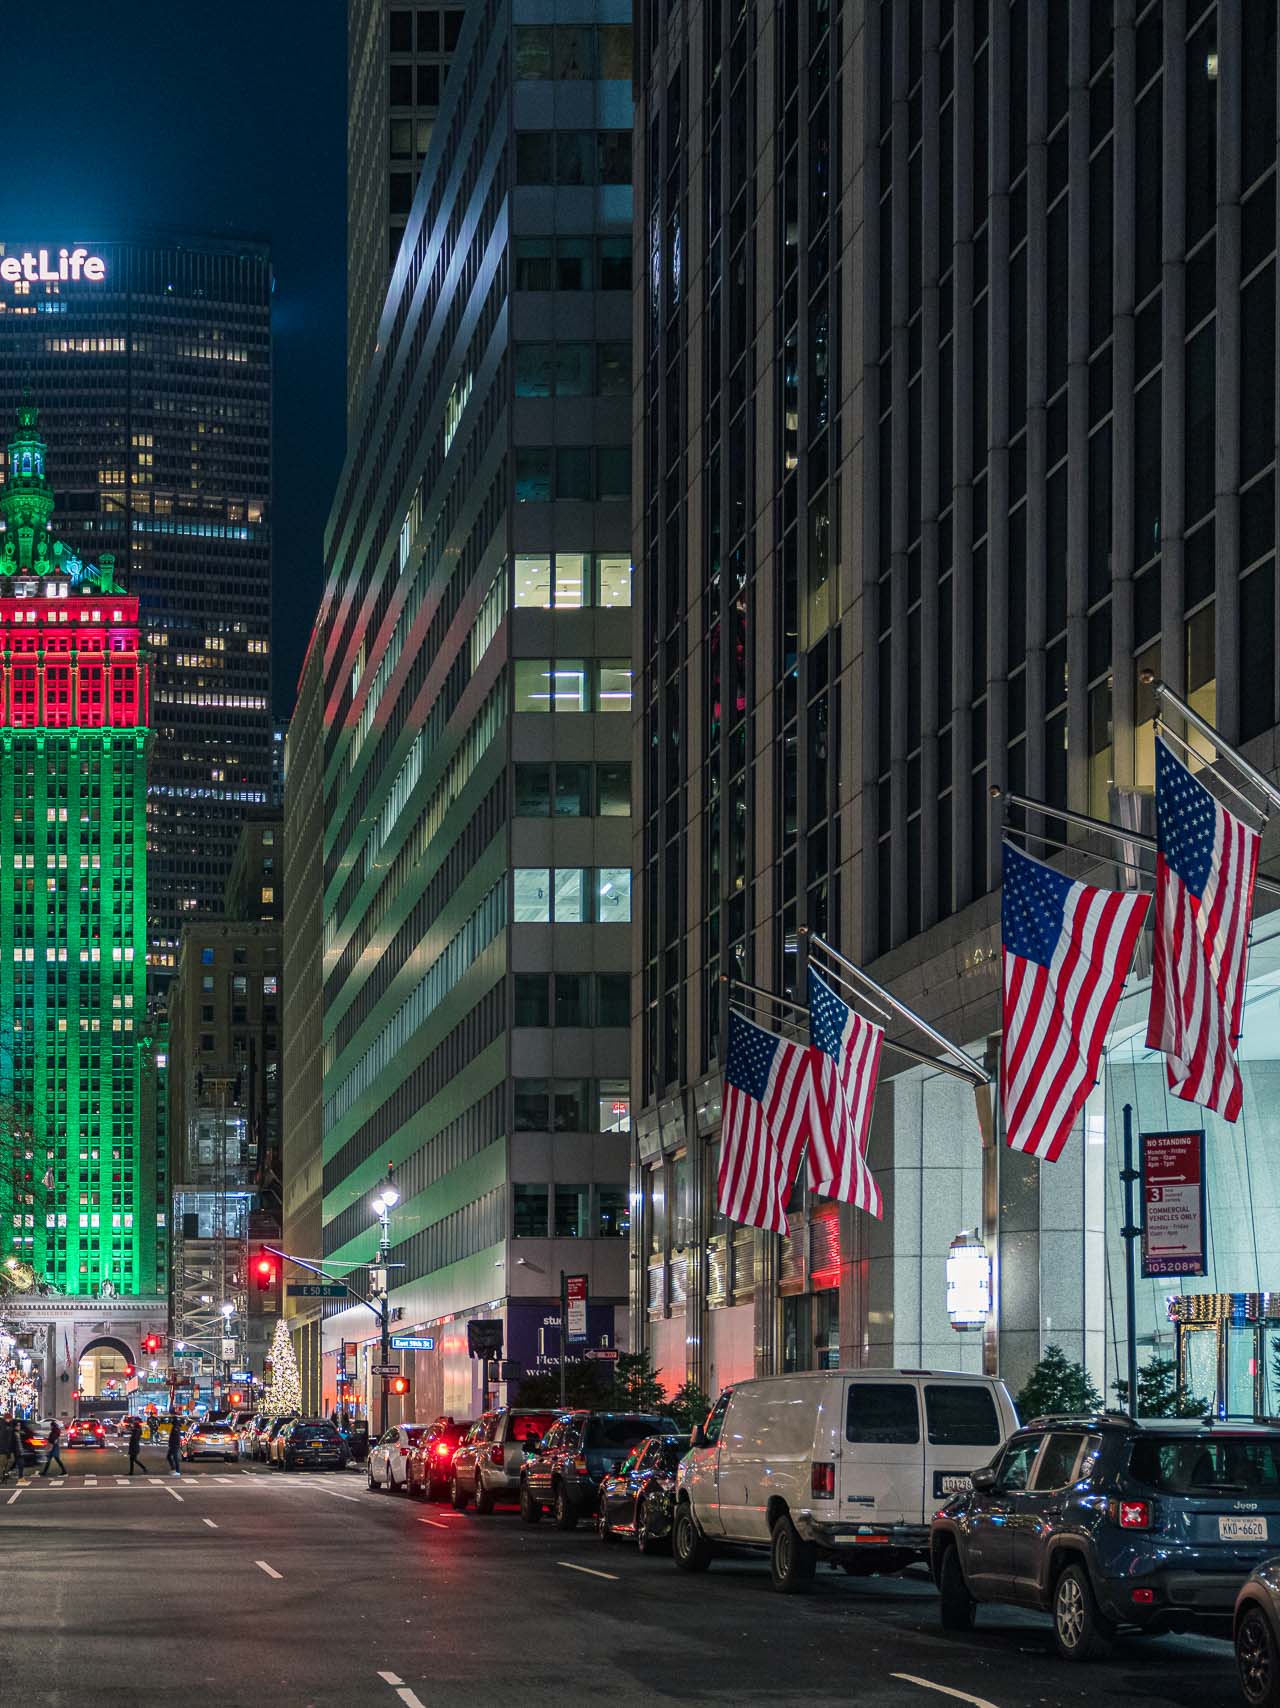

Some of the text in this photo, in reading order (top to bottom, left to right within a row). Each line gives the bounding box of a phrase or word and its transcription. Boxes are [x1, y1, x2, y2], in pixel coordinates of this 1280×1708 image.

[1147, 1137, 1192, 1147] NO STANDING
[1151, 1188, 1160, 1202] 3
[1149, 1205, 1191, 1215] COMMERCIAL
[1149, 1213, 1198, 1222] VEHICLES ONLY
[303, 1286, 331, 1296] E 50 St
[543, 1316, 562, 1325] stu
[395, 1339, 409, 1347] East
[536, 1355, 582, 1365] Flexble
[1233, 1500, 1258, 1512] Jeep
